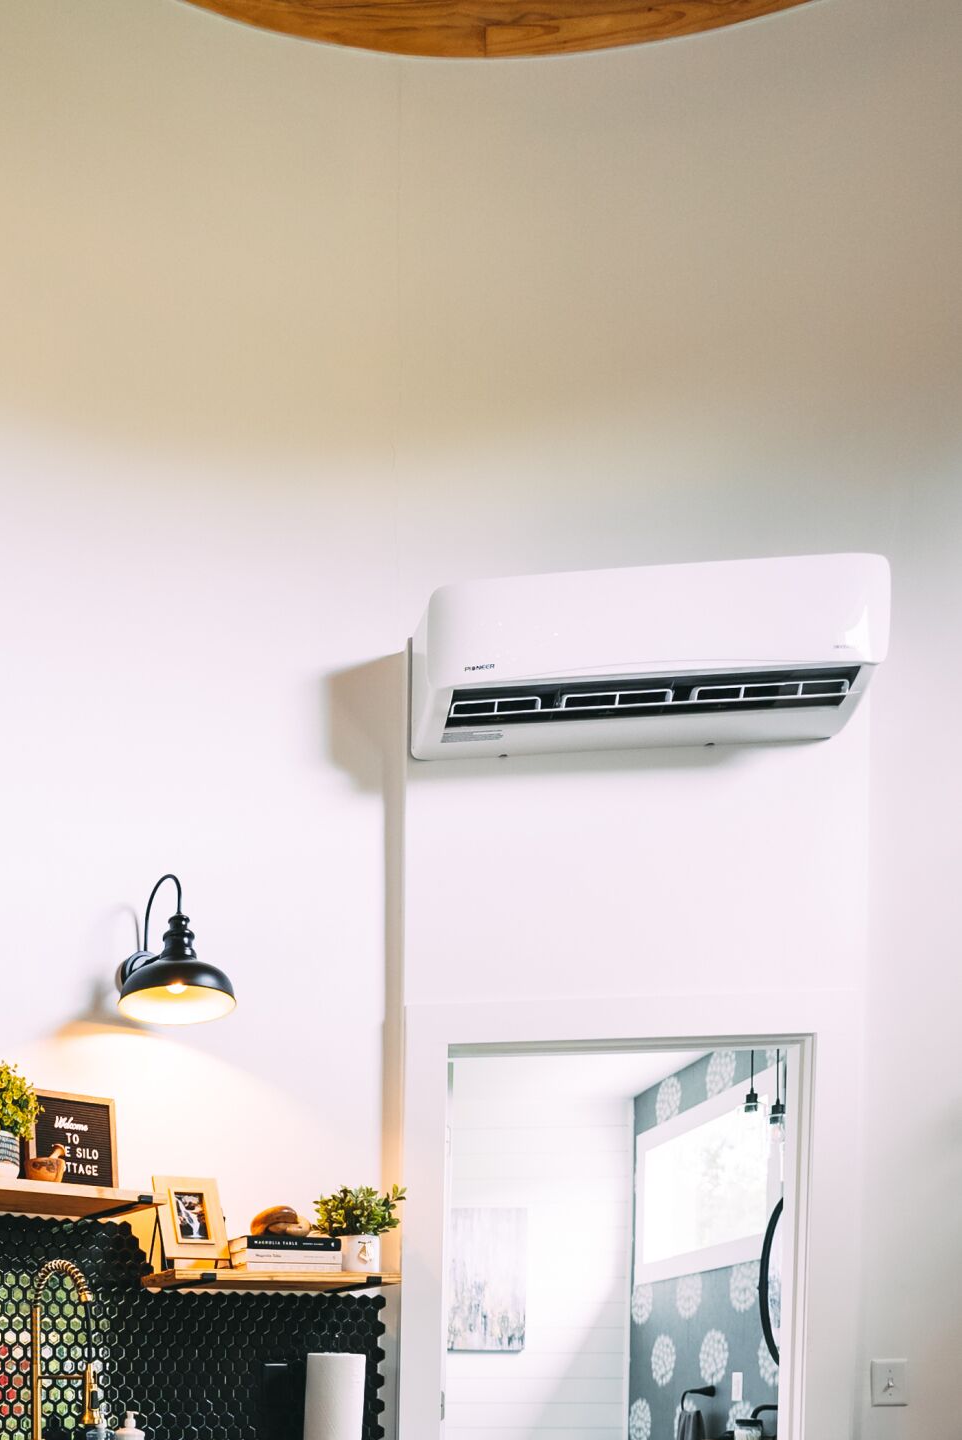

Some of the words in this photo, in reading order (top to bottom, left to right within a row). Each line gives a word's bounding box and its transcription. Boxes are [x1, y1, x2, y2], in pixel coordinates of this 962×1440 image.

[54, 1115, 88, 1131] Welcome
[65, 1133, 79, 1144] TO
[76, 1147, 99, 1160] SILO
[63, 1161, 99, 1176] TTAGE
